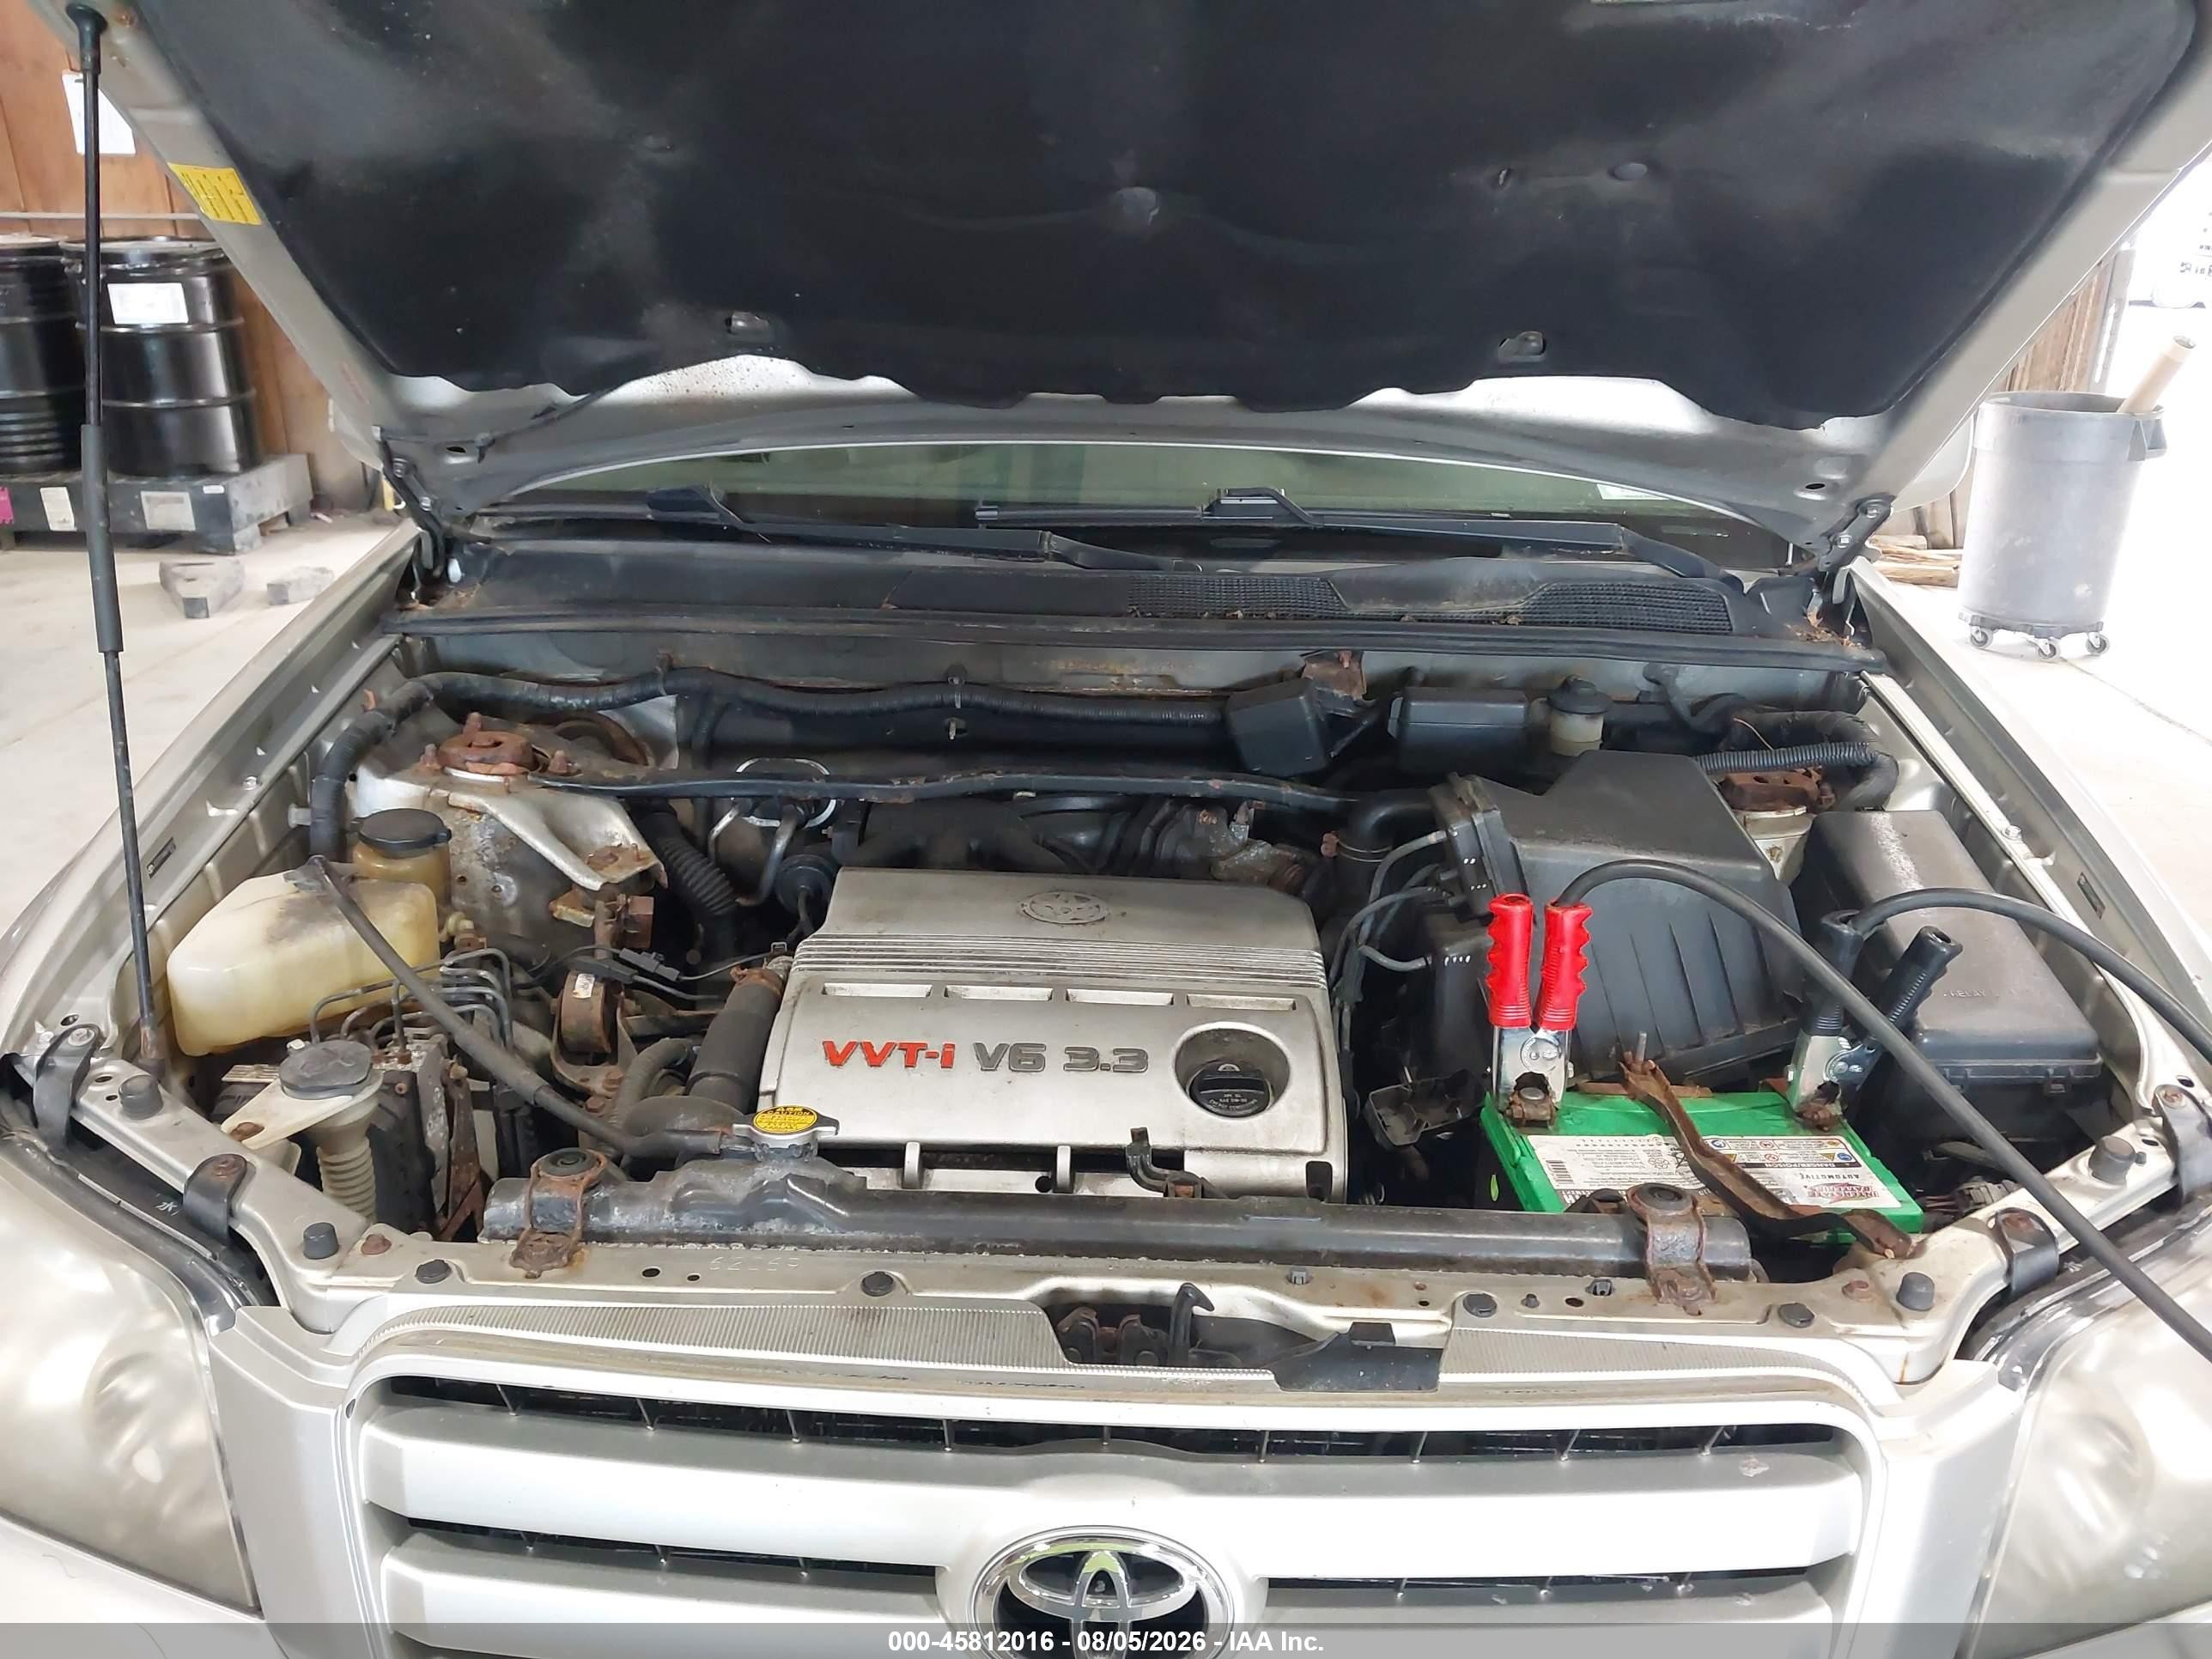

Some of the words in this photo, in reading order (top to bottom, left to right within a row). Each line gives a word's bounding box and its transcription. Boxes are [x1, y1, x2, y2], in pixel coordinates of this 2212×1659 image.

[824, 1041, 955, 1068] VVT-i
[975, 1042, 1046, 1073] V6
[1064, 1047, 1148, 1073] 3.3
